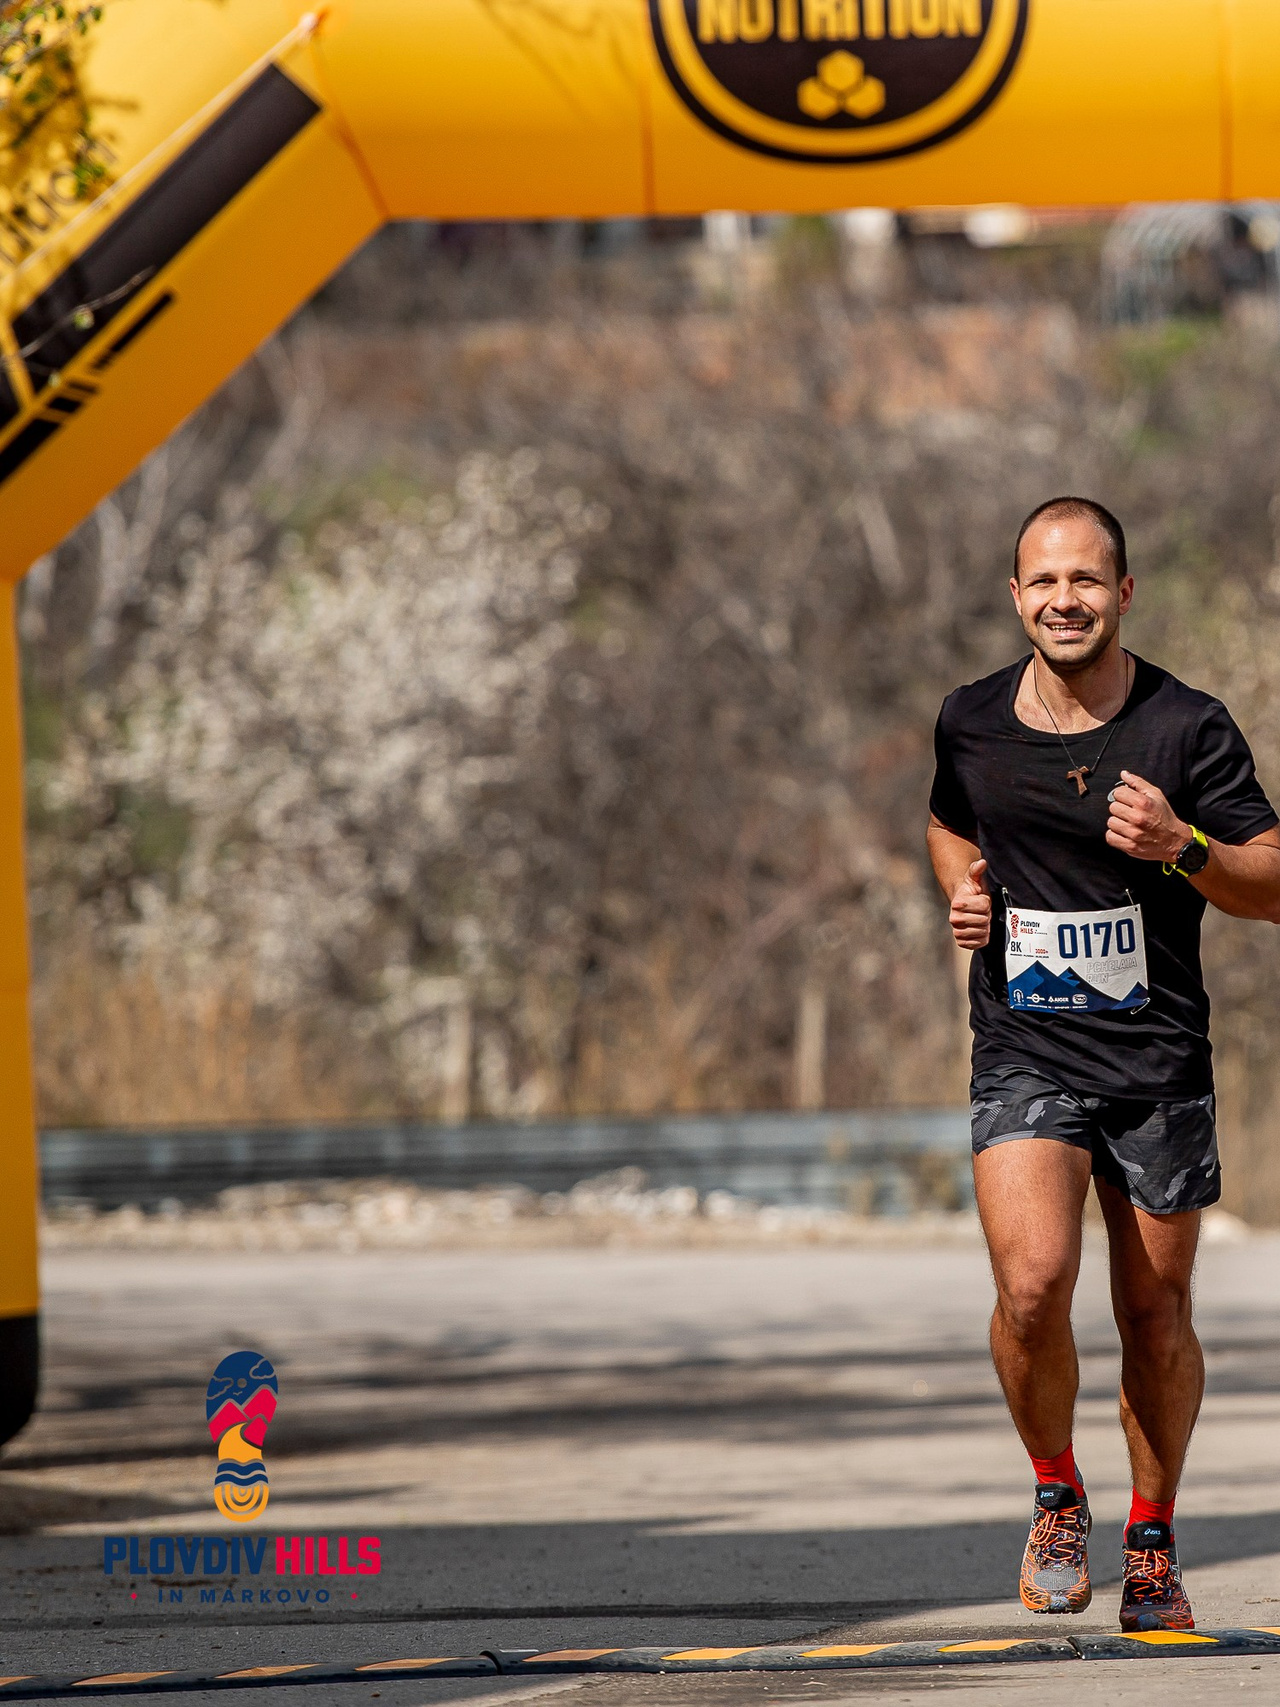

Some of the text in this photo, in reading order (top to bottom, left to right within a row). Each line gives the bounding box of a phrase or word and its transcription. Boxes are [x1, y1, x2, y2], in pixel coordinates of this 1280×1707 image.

[1020, 920, 1040, 928] PLOVDIV
[1057, 918, 1136, 959] 0170
[1010, 941, 1022, 953] 8K
[1086, 957, 1138, 973] PCHELATA
